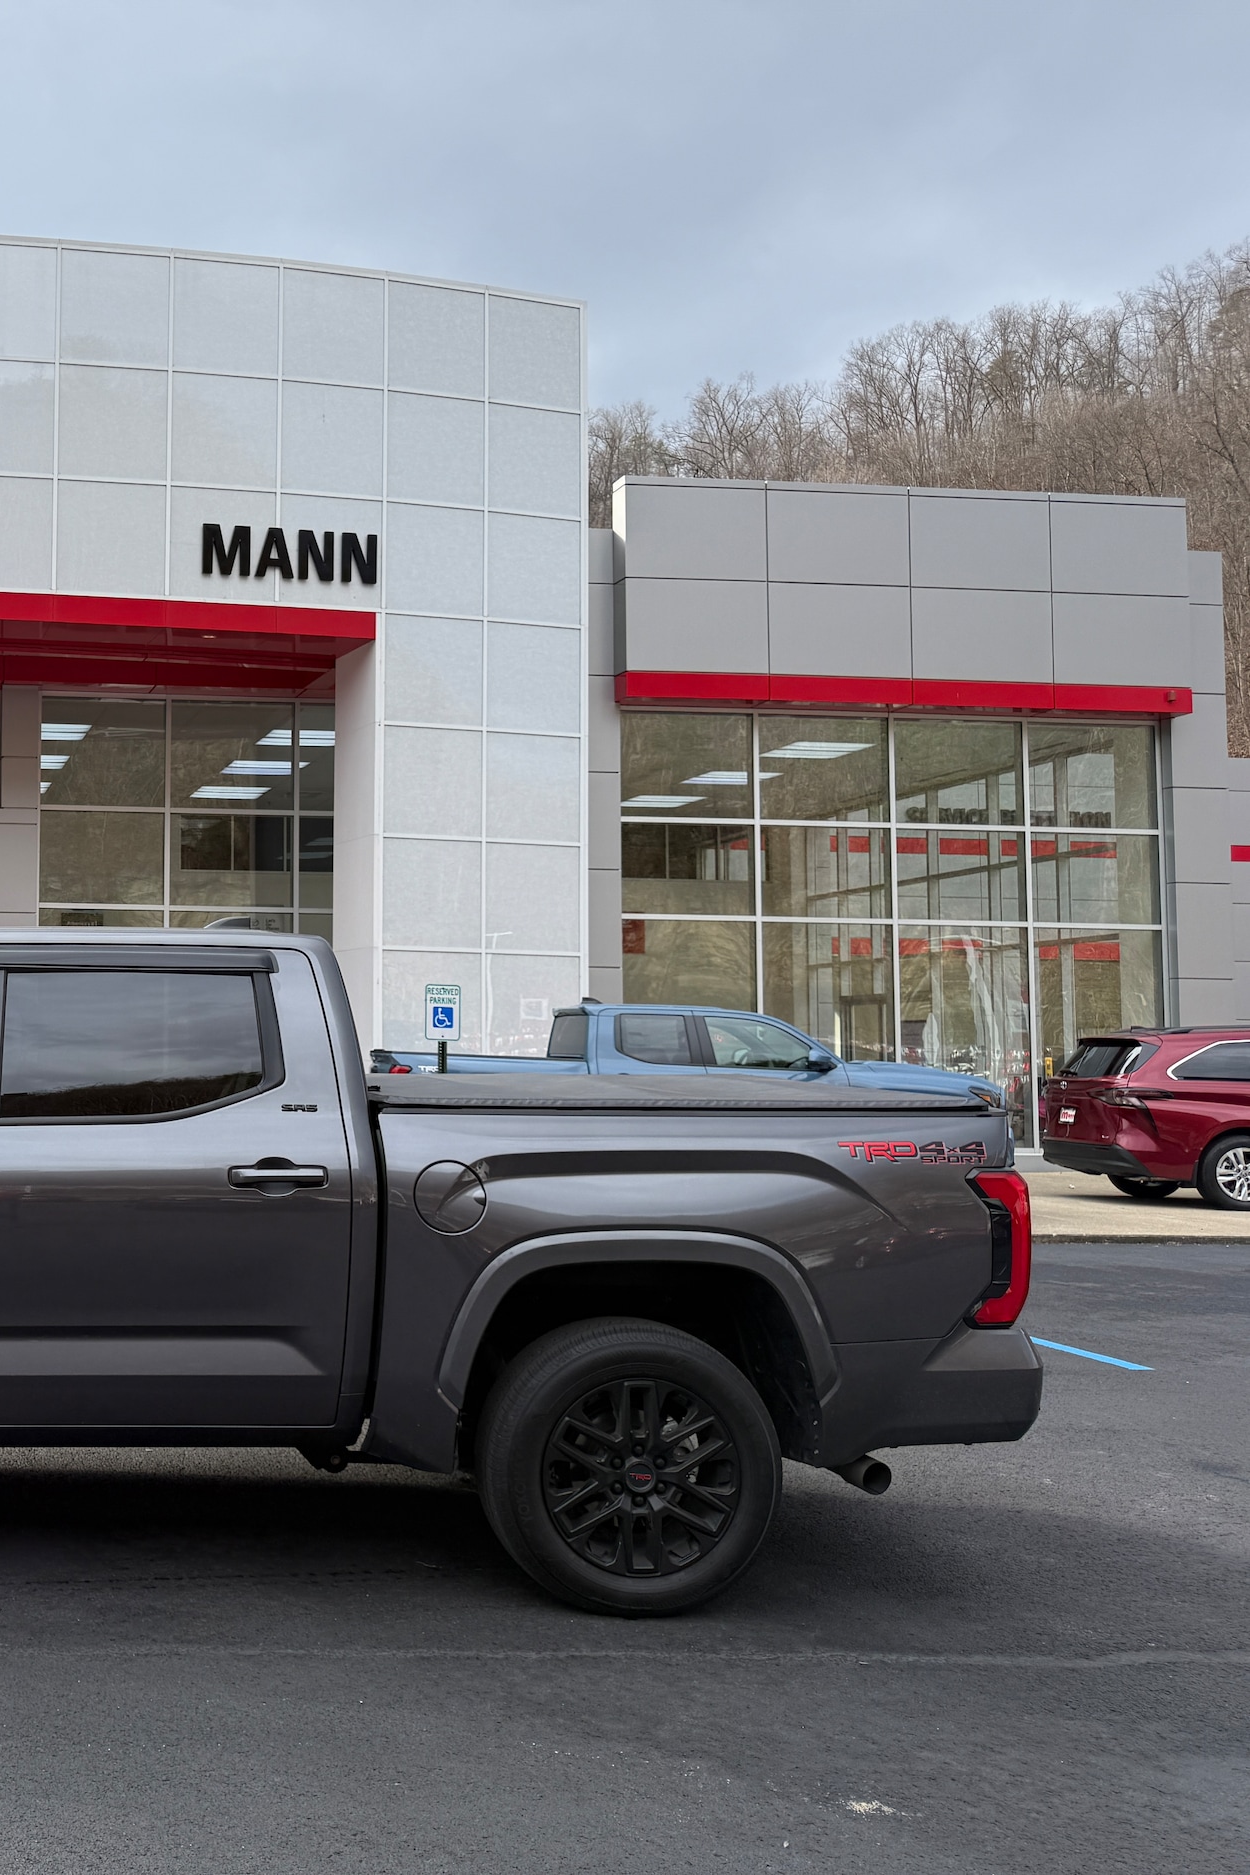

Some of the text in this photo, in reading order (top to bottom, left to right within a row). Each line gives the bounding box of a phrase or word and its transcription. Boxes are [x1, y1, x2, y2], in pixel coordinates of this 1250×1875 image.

[201, 522, 378, 585] MANN
[427, 987, 459, 996] RESERVED
[429, 996, 457, 1005] PARKING
[281, 1103, 318, 1112] SR5
[837, 1140, 919, 1164] TRD
[920, 1154, 988, 1165] SPORT
[629, 1472, 652, 1481] TRD
